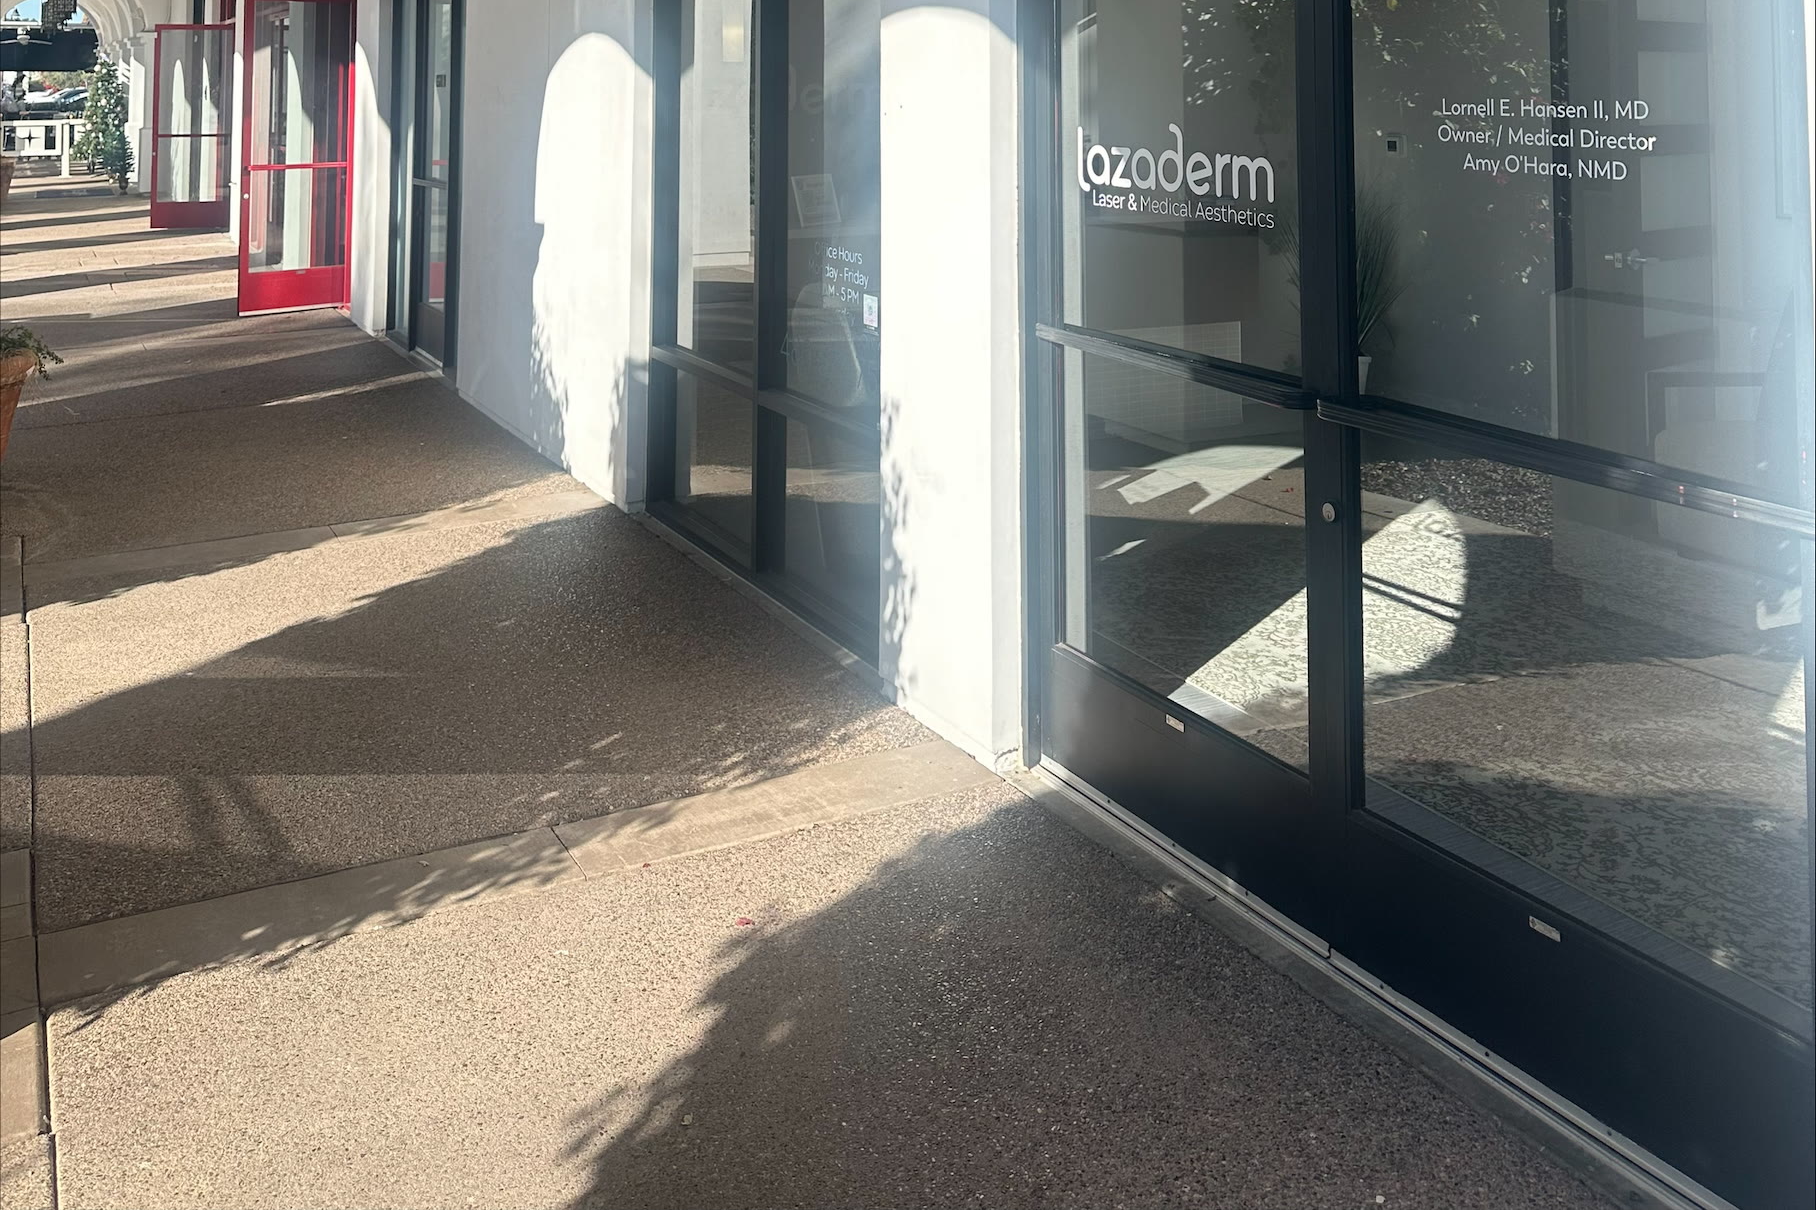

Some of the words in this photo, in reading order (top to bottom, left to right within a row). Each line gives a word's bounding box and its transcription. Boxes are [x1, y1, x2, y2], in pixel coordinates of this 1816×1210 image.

[1442, 98, 1494, 118] Lornell
[1500, 98, 1515, 117] E.
[1520, 99, 1588, 119] Hansen
[1594, 100, 1609, 122] II,
[1615, 100, 1649, 120] MD
[1438, 124, 1491, 144] Owner
[1496, 125, 1503, 147] /
[1508, 127, 1574, 148] Medical
[1580, 129, 1657, 151] Director
[1077, 123, 1275, 204] lazaderm
[1463, 153, 1500, 176] Amy
[1505, 155, 1573, 179] O'Hara,
[1578, 159, 1628, 181] NMD
[1093, 190, 1126, 210] Laser
[1128, 192, 1138, 211] &
[1140, 195, 1192, 218] Medical
[1195, 202, 1275, 229] Aesthetics
[815, 242, 838, 260] Oice
[838, 246, 863, 265] Hours
[844, 267, 869, 289] Friday
[841, 287, 846, 302] 5
[847, 288, 860, 305] PM
